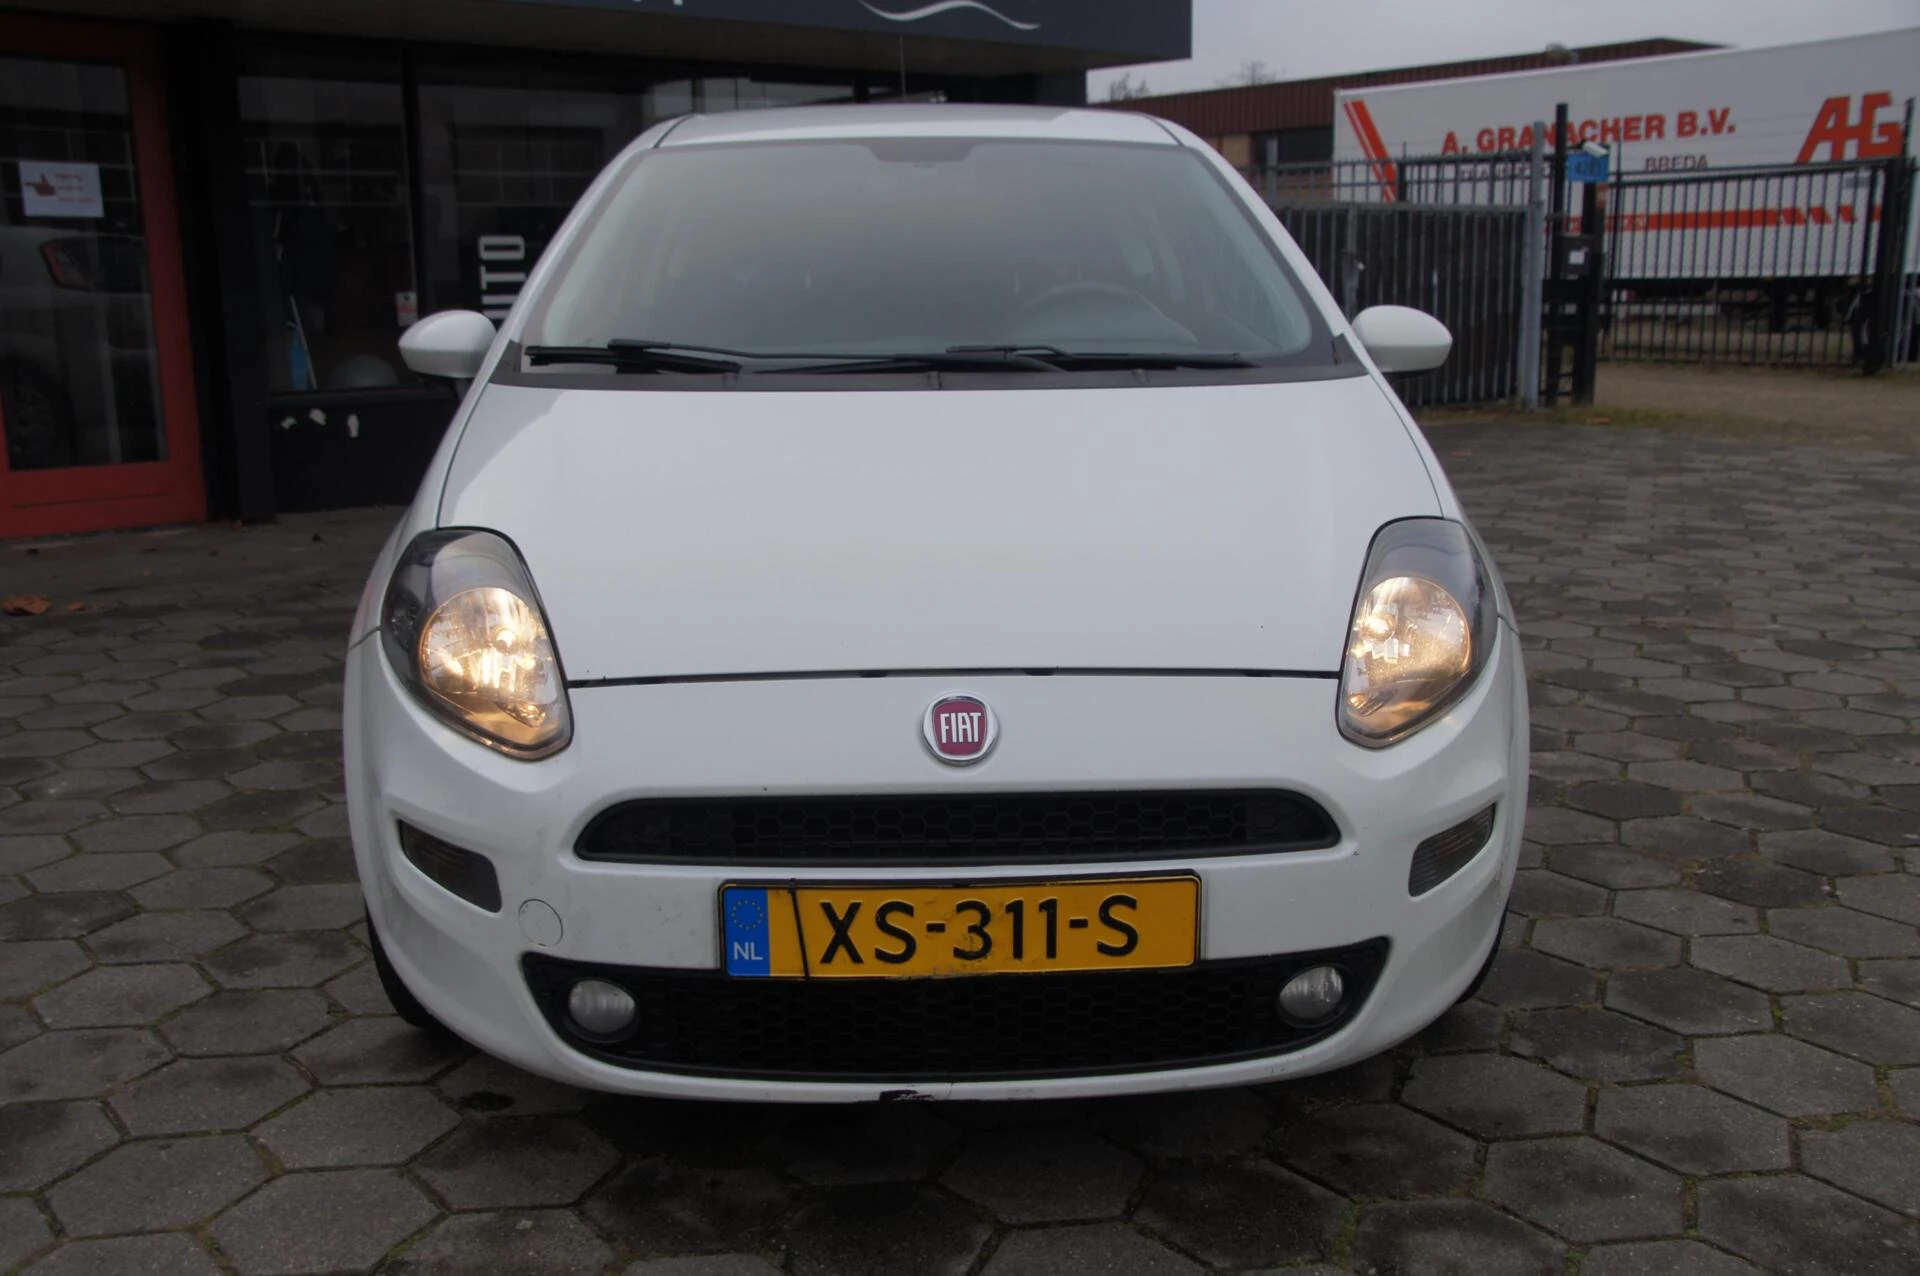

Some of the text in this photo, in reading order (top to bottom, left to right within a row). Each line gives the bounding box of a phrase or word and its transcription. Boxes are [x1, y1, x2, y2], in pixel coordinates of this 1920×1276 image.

[1441, 131, 1469, 155] A.
[1677, 108, 1736, 138] B.V.
[1645, 154, 1708, 172] BREDA
[940, 712, 982, 743] FIAT
[819, 895, 1138, 964] XS-311-S
[733, 941, 764, 960] NL
